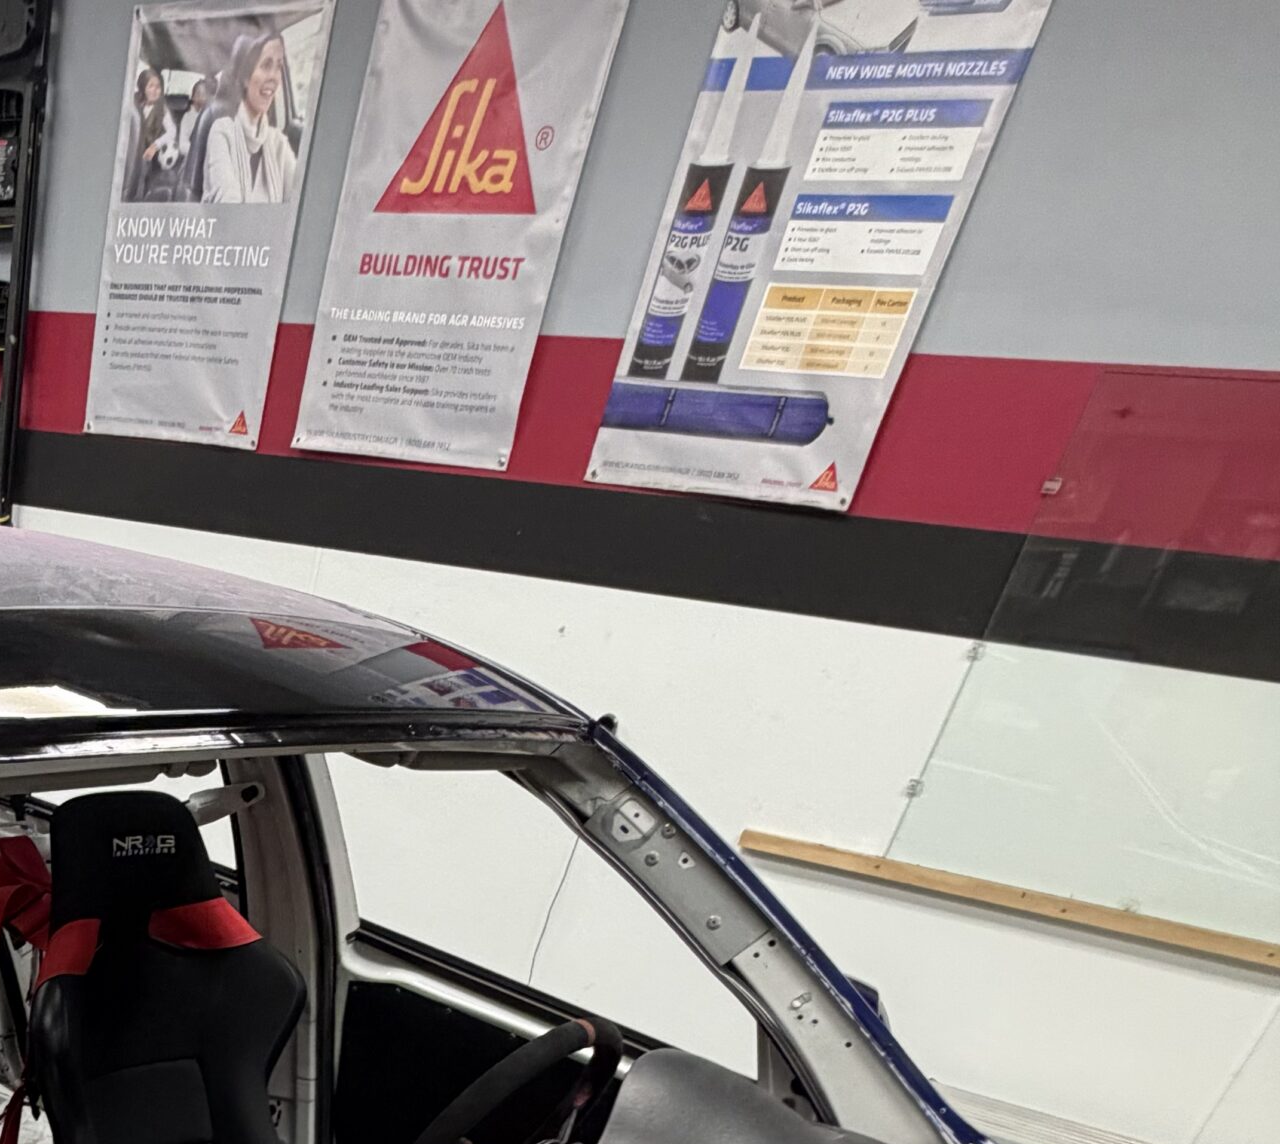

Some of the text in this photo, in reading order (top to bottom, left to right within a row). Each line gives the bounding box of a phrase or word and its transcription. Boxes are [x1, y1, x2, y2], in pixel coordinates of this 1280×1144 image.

[826, 60, 1008, 80] NEW WIDE MOUTH NOZZLES
[881, 109, 904, 123] P2G
[906, 108, 937, 122] PLUS
[400, 78, 518, 195] Sika
[846, 203, 870, 216] P2G
[116, 217, 217, 239] KNOW WHAT
[725, 235, 750, 252] P2G
[115, 243, 270, 267] YOU'RE PROTECTING
[359, 253, 525, 280] BUILDING TRUST
[331, 307, 525, 329] THE LEADING BRAND FOR AGR ADHESIVES
